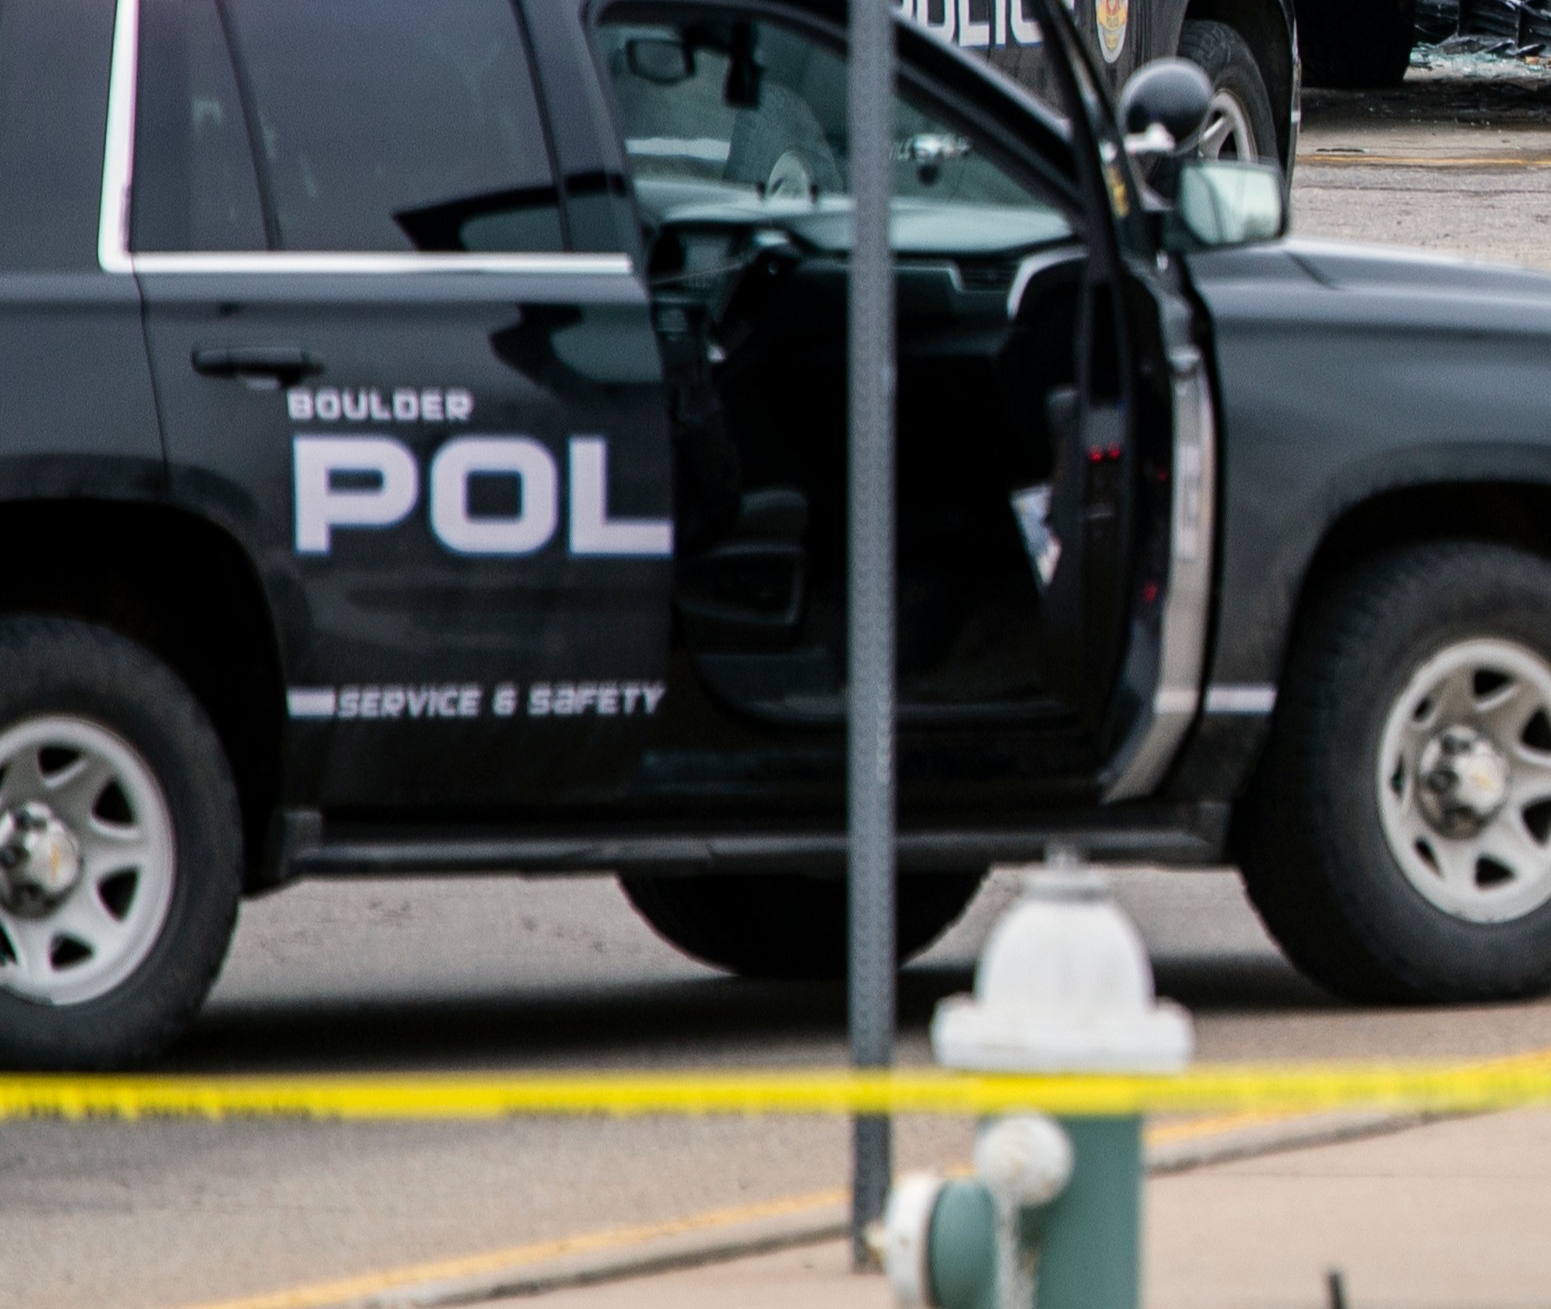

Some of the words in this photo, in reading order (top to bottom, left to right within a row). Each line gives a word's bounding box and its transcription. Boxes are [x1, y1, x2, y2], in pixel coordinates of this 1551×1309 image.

[287, 388, 474, 421] BOULDER
[293, 433, 674, 559] POL
[337, 682, 481, 719] SERVICE
[528, 680, 665, 716] SAFETY
